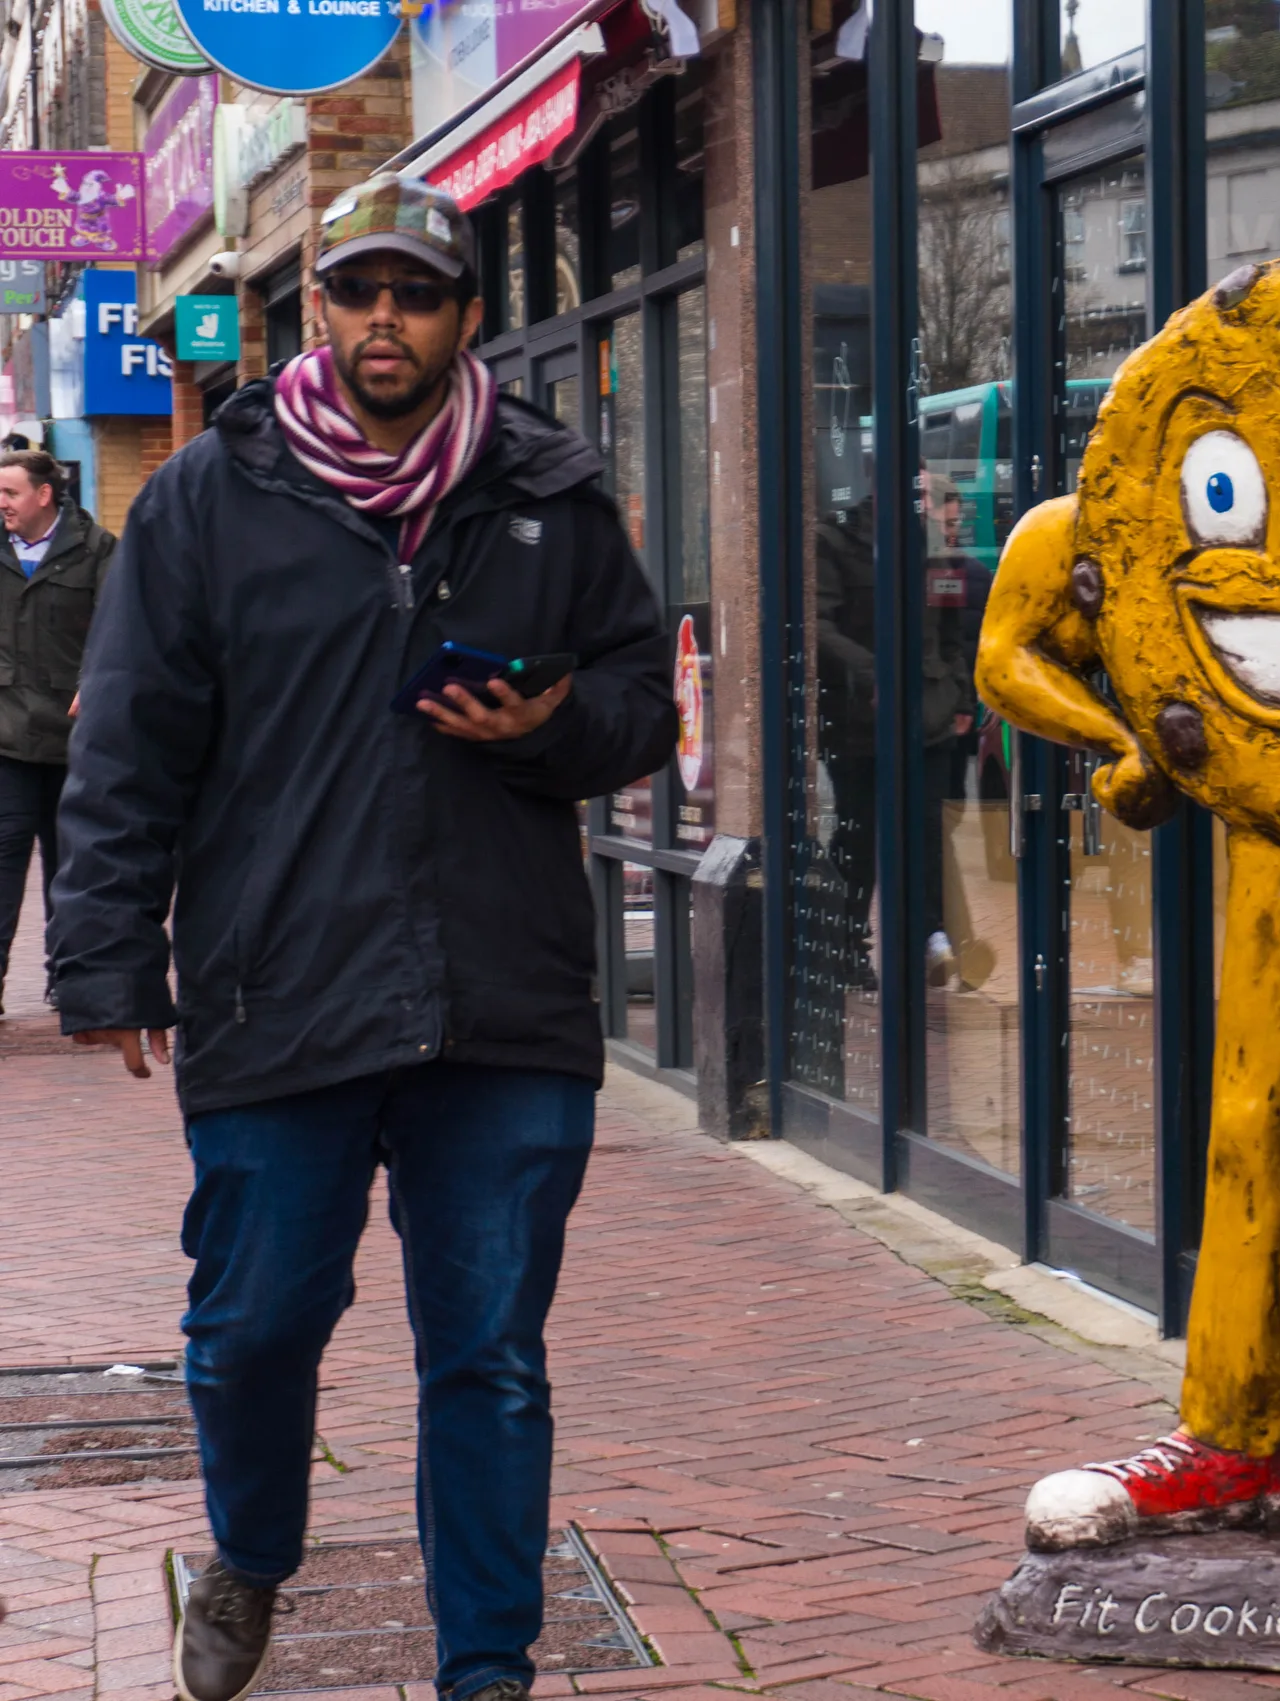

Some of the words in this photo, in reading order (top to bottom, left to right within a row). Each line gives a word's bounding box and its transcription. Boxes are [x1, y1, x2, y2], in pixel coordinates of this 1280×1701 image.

[203, 0, 279, 13] KITCHEN
[287, 0, 301, 14] &
[309, 1, 381, 16] LOUNGE
[0, 207, 73, 227] OLDEN
[0, 228, 67, 247] OUCH
